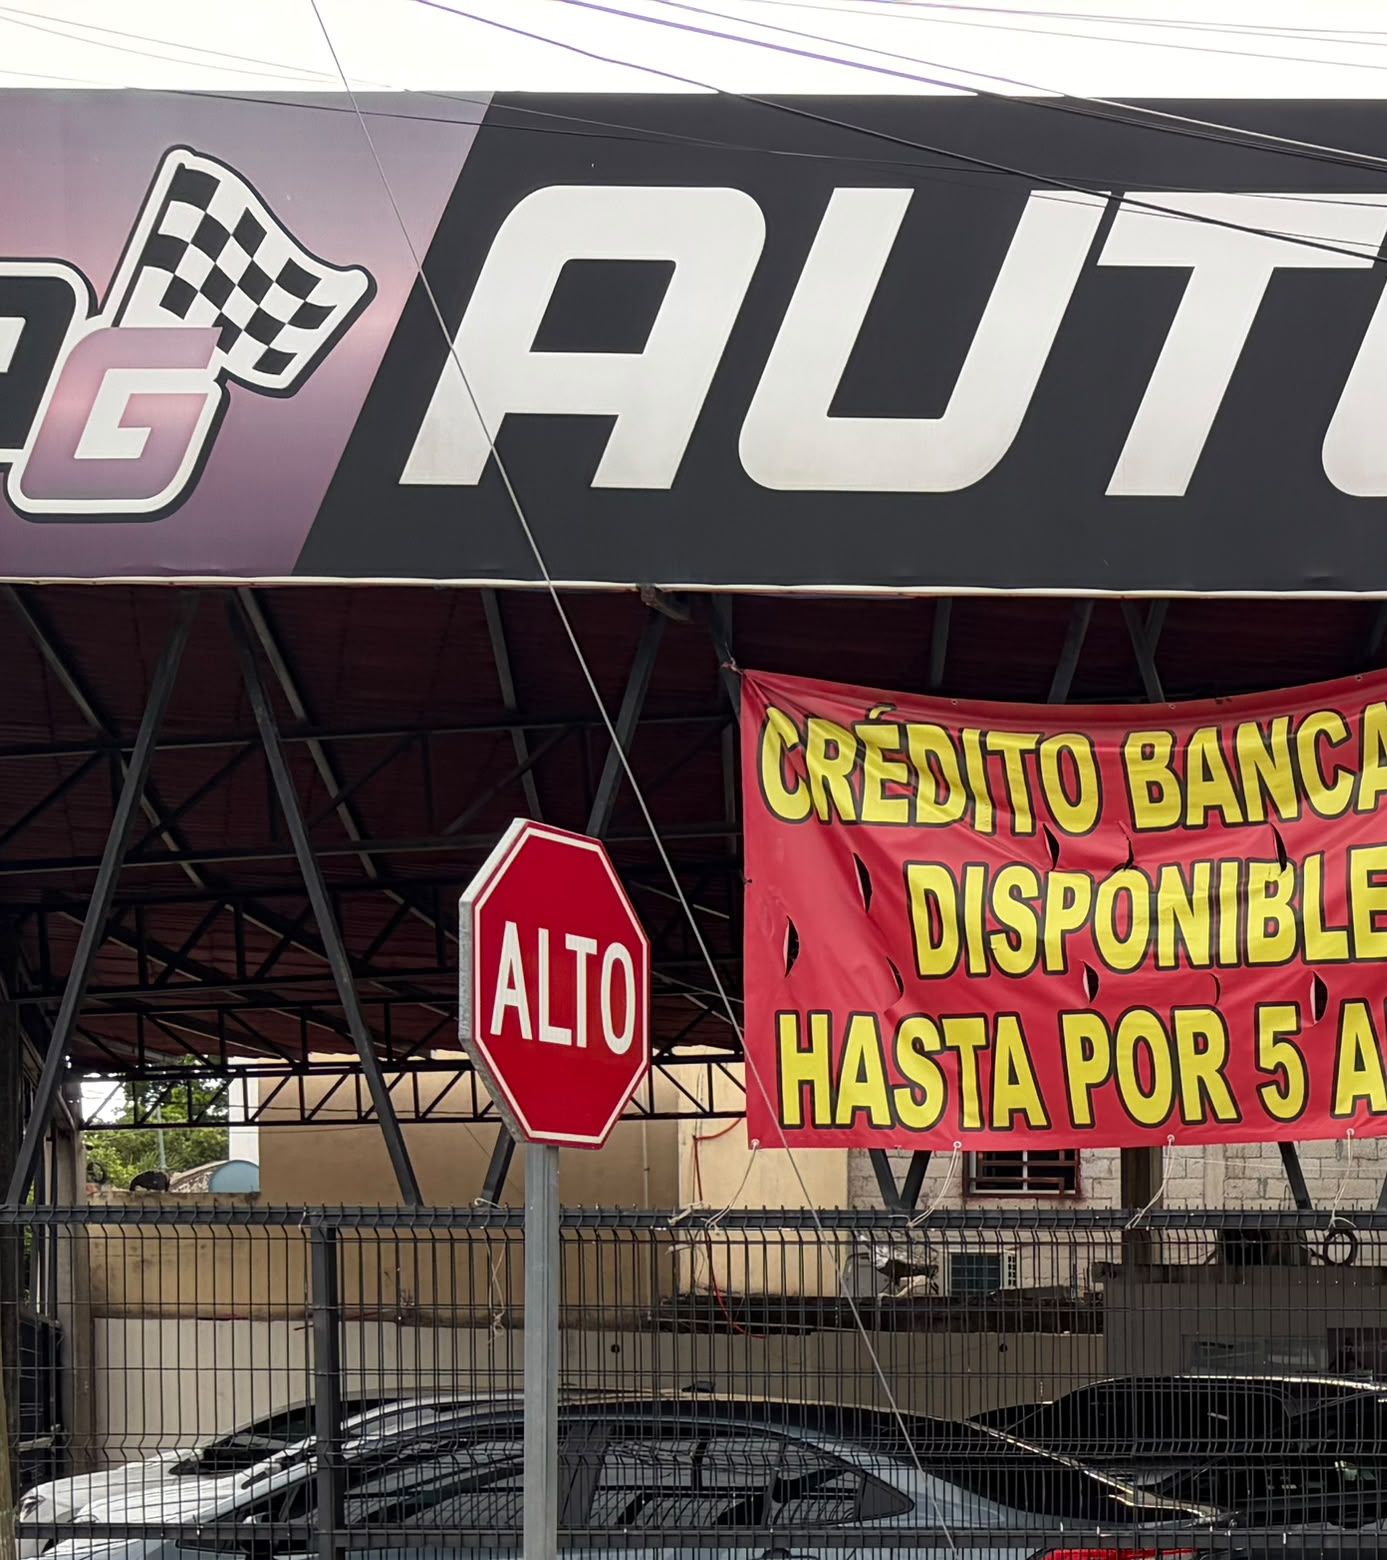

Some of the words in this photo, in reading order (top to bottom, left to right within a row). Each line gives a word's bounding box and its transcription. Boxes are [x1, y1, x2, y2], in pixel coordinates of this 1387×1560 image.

[757, 705, 1102, 836] CRÉDITO
[490, 920, 636, 1055] ALTO
[775, 1009, 1051, 1131] HASTA
[1059, 1006, 1240, 1129] POR
[1255, 1002, 1309, 1123] 5
